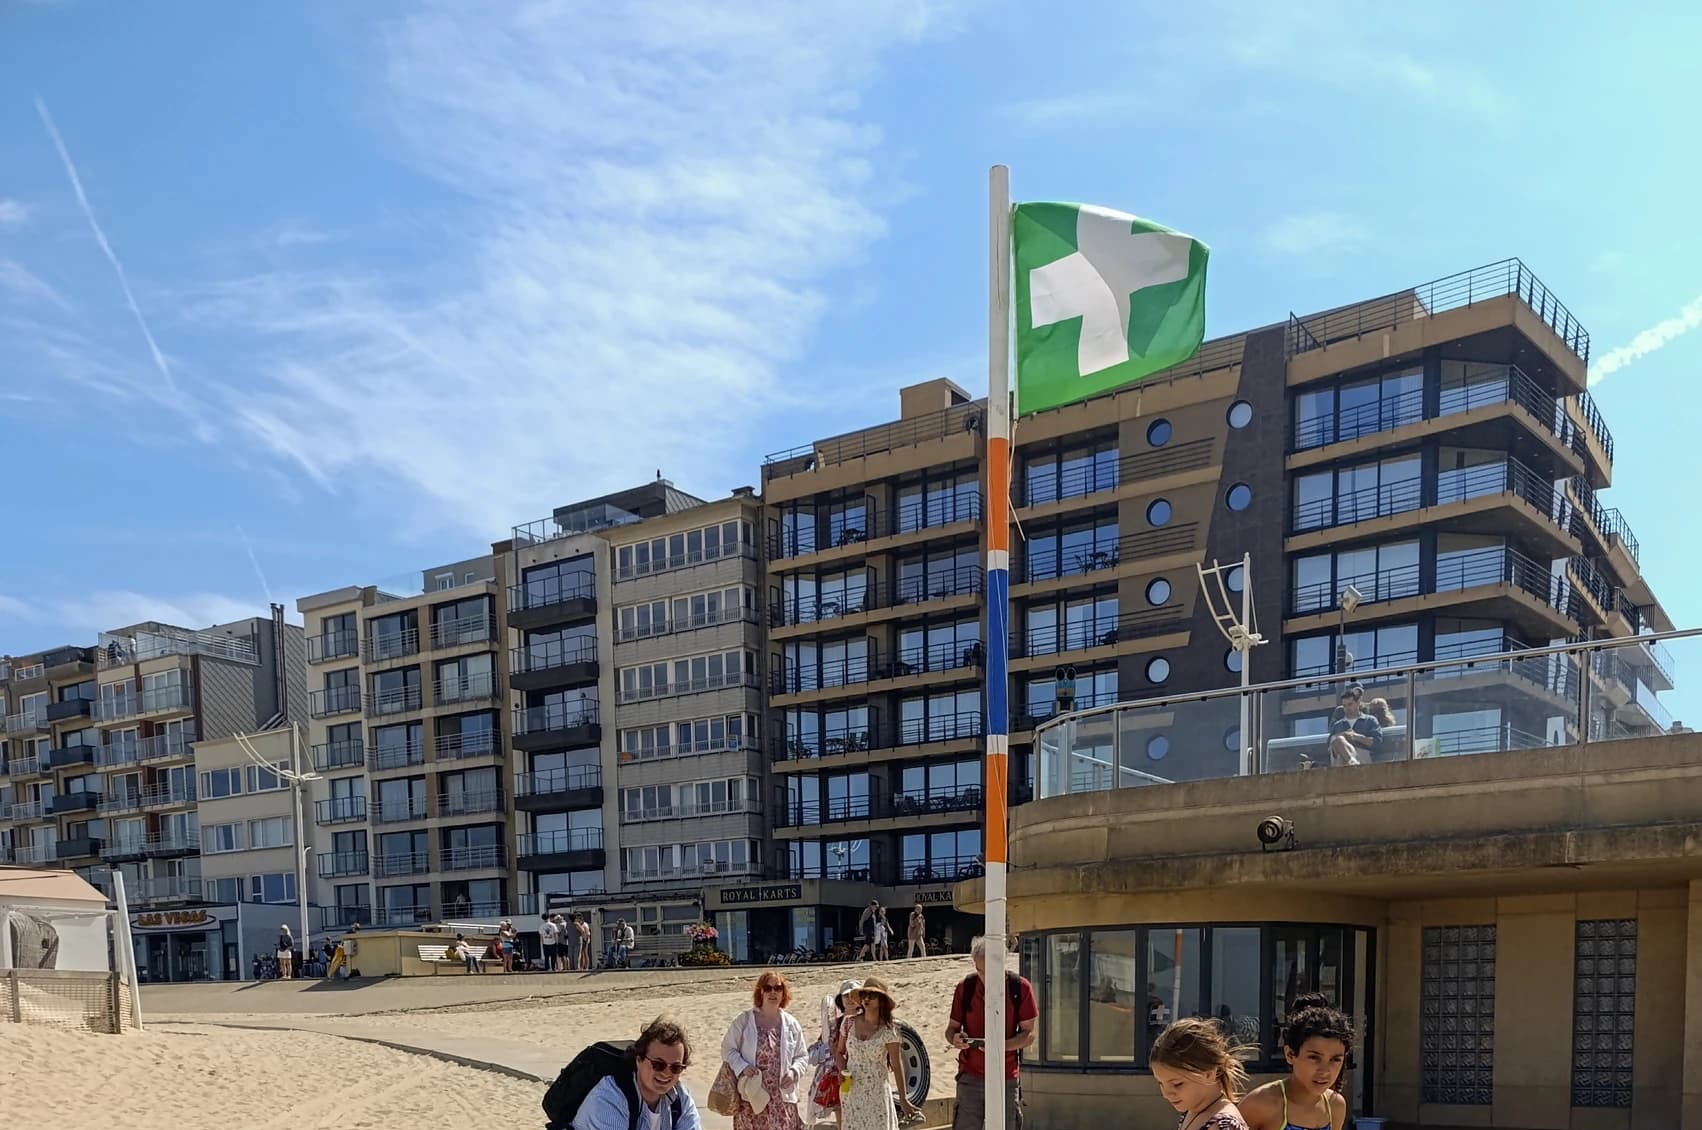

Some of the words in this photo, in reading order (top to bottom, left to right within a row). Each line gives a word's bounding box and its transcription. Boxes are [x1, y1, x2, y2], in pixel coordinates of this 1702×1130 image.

[722, 891, 756, 902] ROYAL
[763, 887, 797, 900] KARTS
[164, 910, 208, 925] VEGAS
